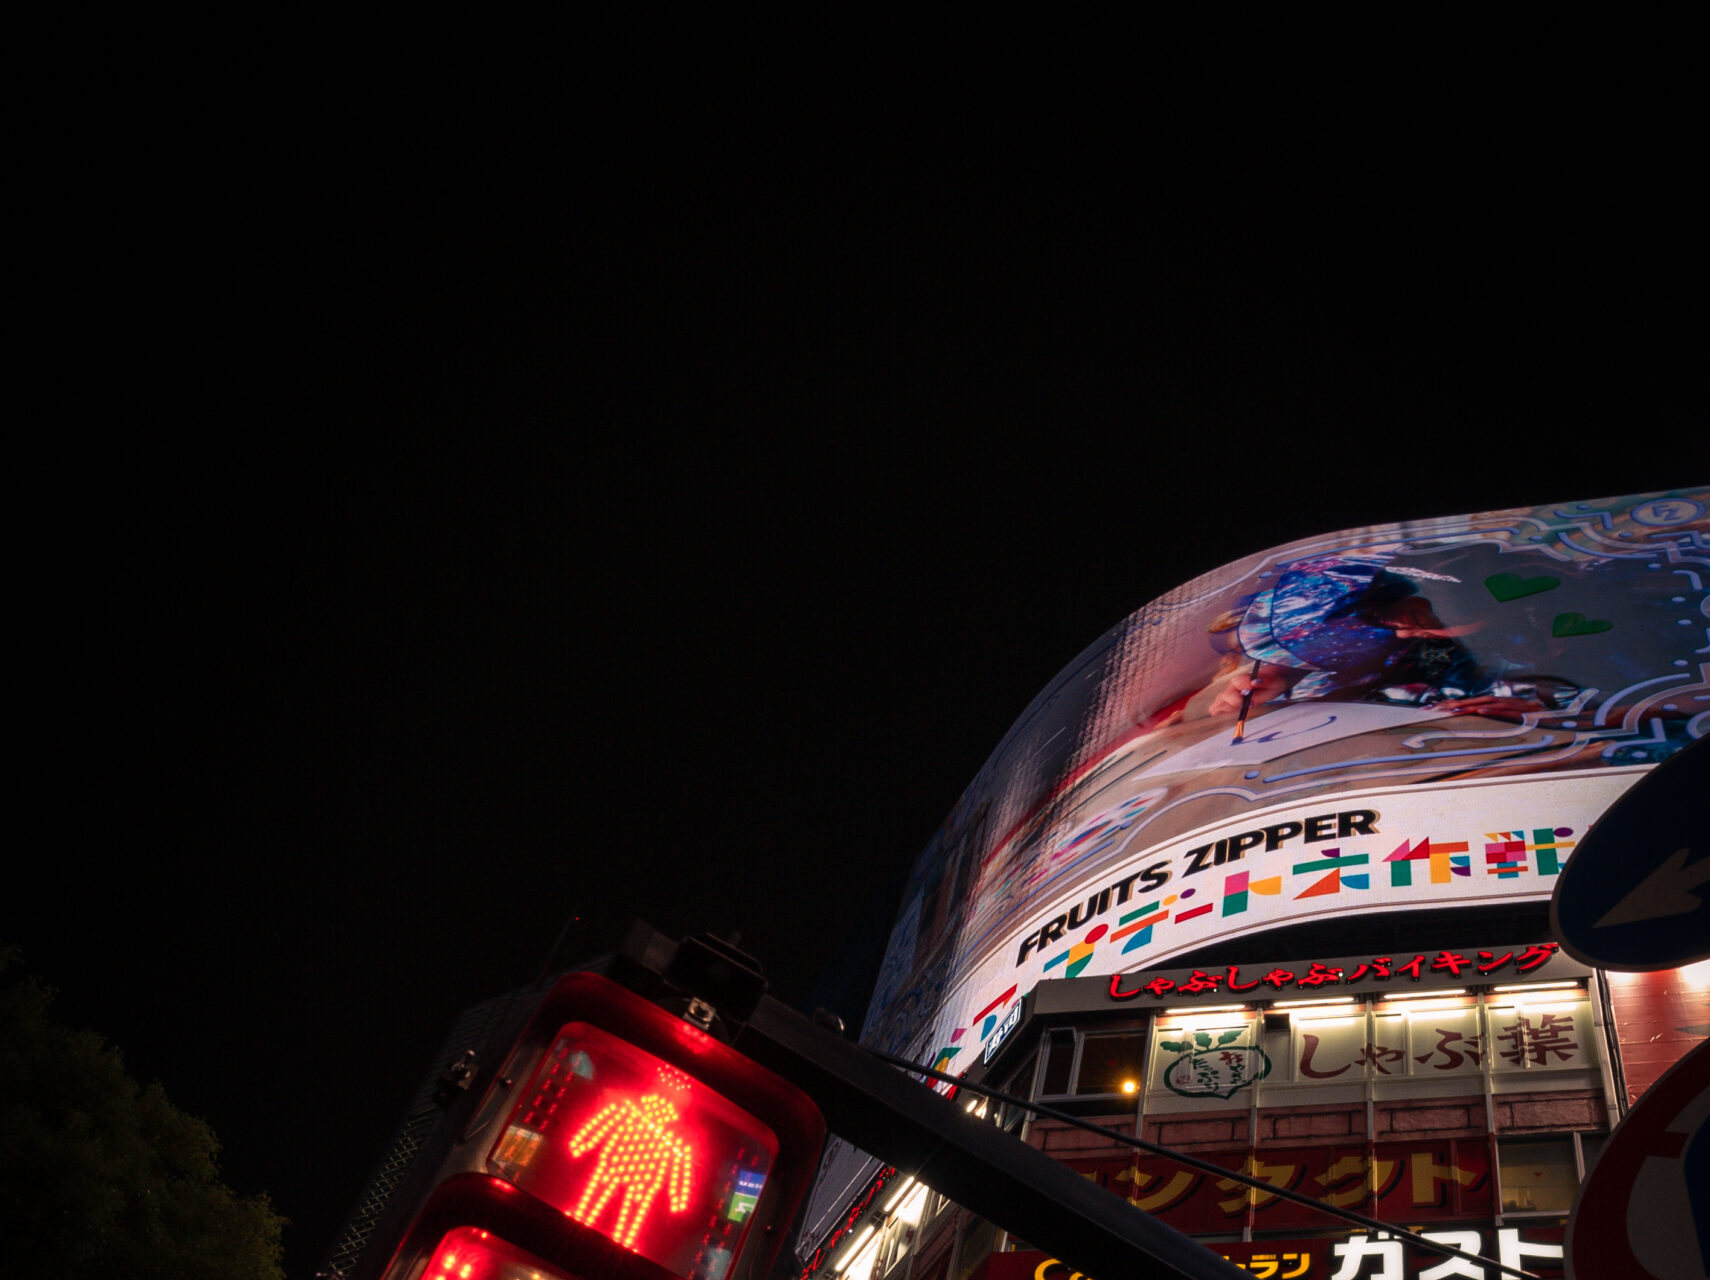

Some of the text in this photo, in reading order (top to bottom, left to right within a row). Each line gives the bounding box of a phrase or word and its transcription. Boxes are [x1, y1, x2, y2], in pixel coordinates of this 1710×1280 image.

[1016, 808, 1381, 968] FRUITS ZIPPER
[1109, 943, 1559, 1001] しゃぶしゃぶバイキング
[1300, 1014, 1579, 1079] しゃぶ葉
[1078, 1152, 1478, 1213] ンタクト
